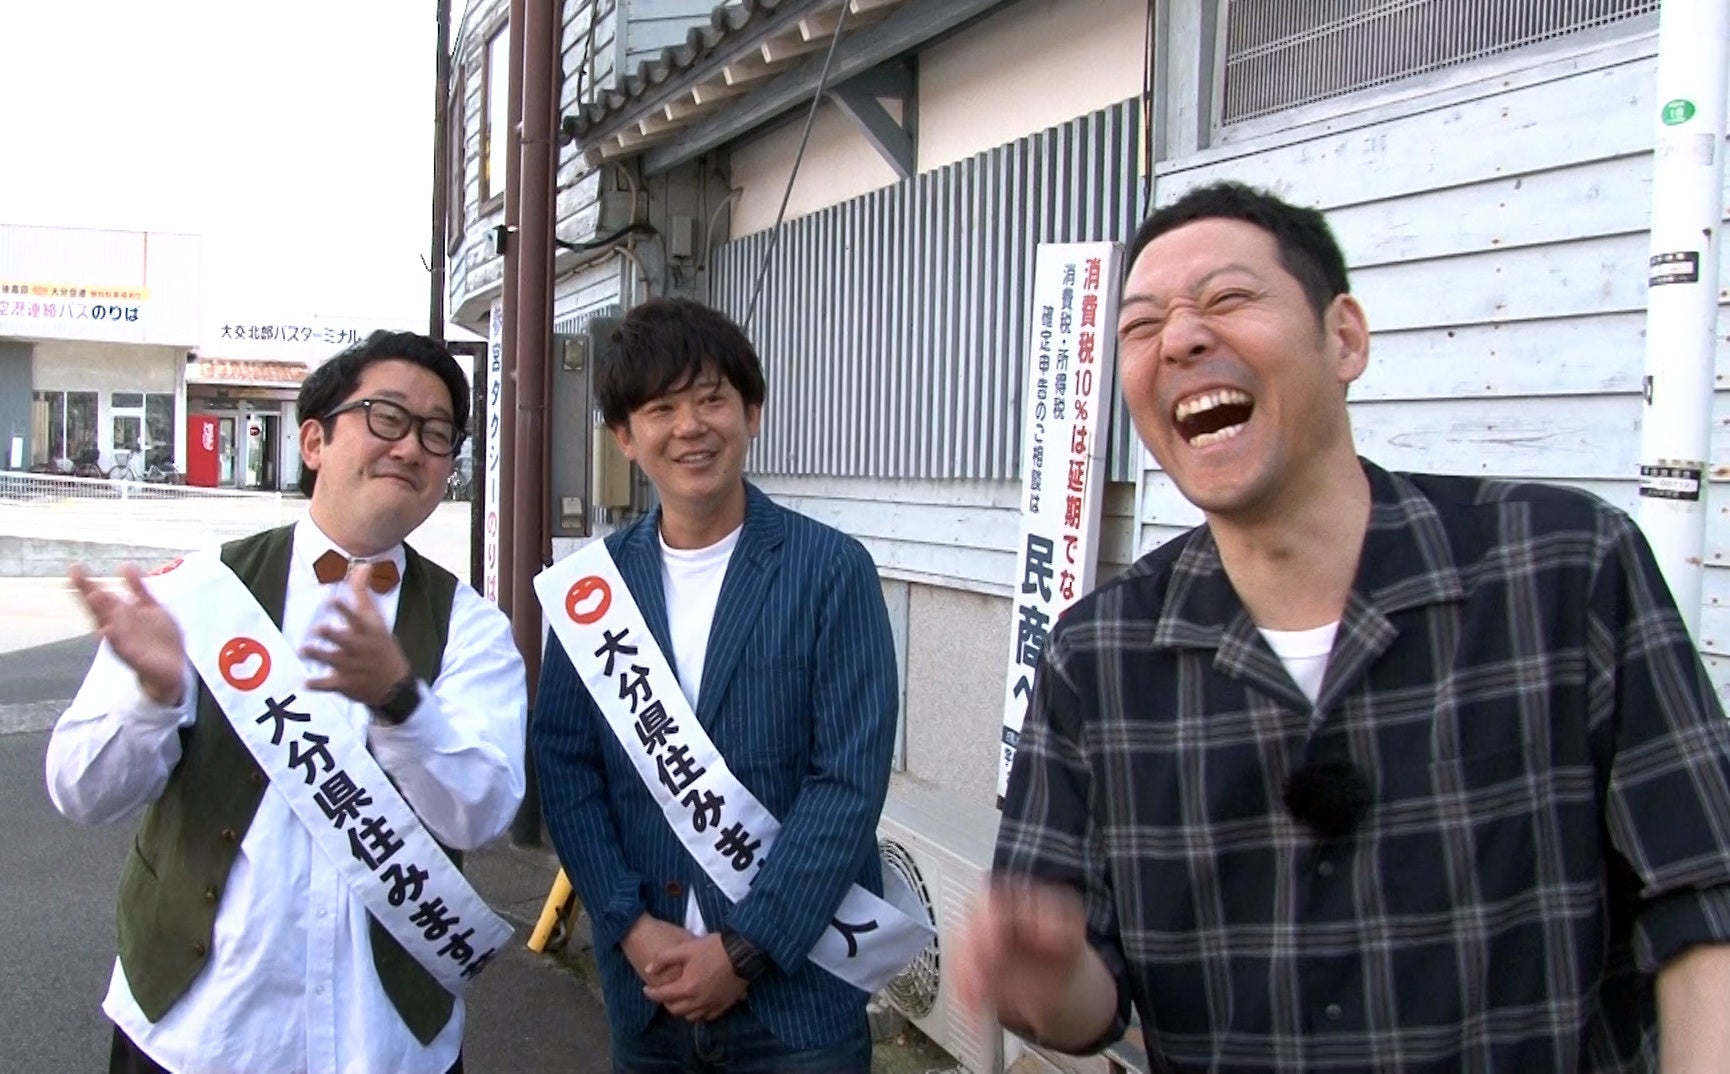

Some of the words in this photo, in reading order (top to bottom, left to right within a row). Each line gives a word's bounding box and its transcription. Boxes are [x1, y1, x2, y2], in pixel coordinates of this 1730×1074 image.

[221, 324, 362, 344] 大交北部バスターミナル
[1029, 305, 1054, 514] 確定申告のご相談は
[1058, 257, 1102, 619] 消費税10%は延期でな
[594, 627, 767, 887] 大分県住みま
